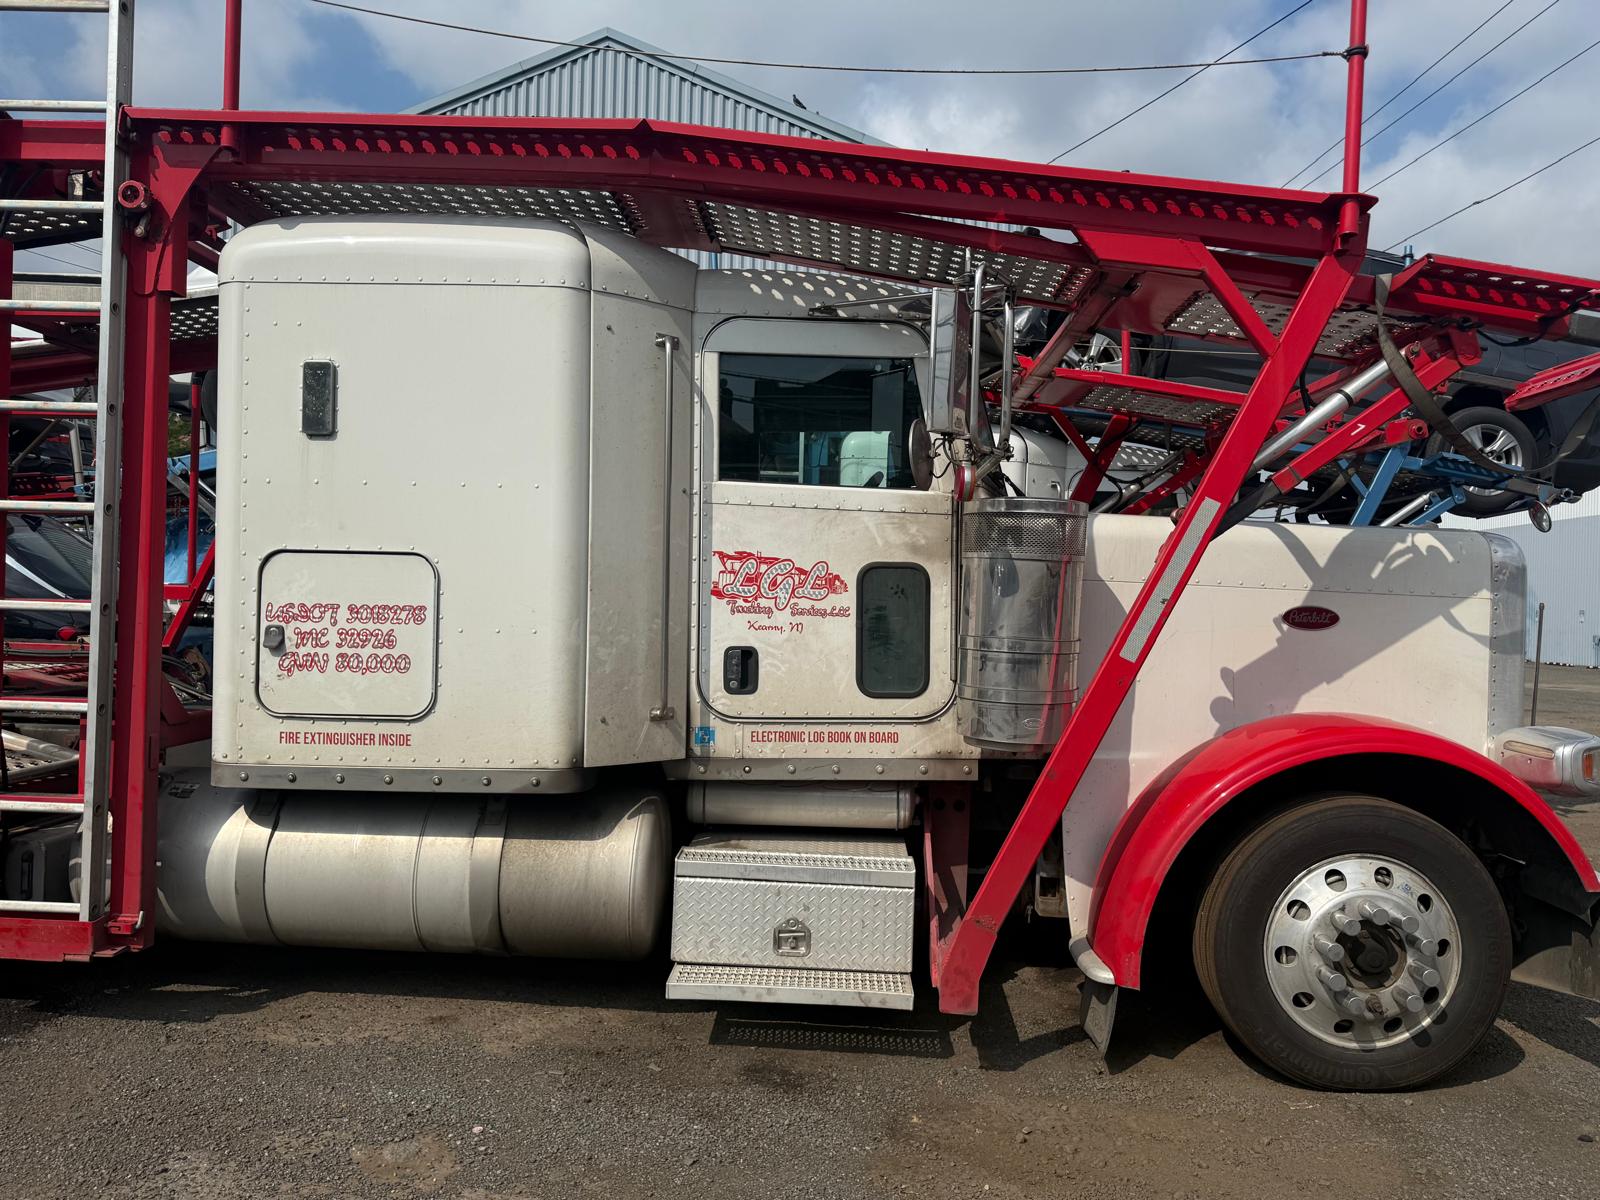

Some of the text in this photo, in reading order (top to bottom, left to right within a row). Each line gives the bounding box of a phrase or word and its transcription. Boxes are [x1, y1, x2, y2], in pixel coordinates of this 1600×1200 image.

[722, 557, 829, 611] LGL
[265, 602, 427, 626] USDOT 3018278
[726, 599, 851, 618] Trucking Services LLC
[294, 627, 397, 650] MC 32926
[278, 651, 411, 677] GVW 80,000
[279, 731, 412, 747] FIRE EXTINGUISHER INSIDE
[750, 730, 900, 744] ELECTRONIC LOG BOOK ON BOARD
